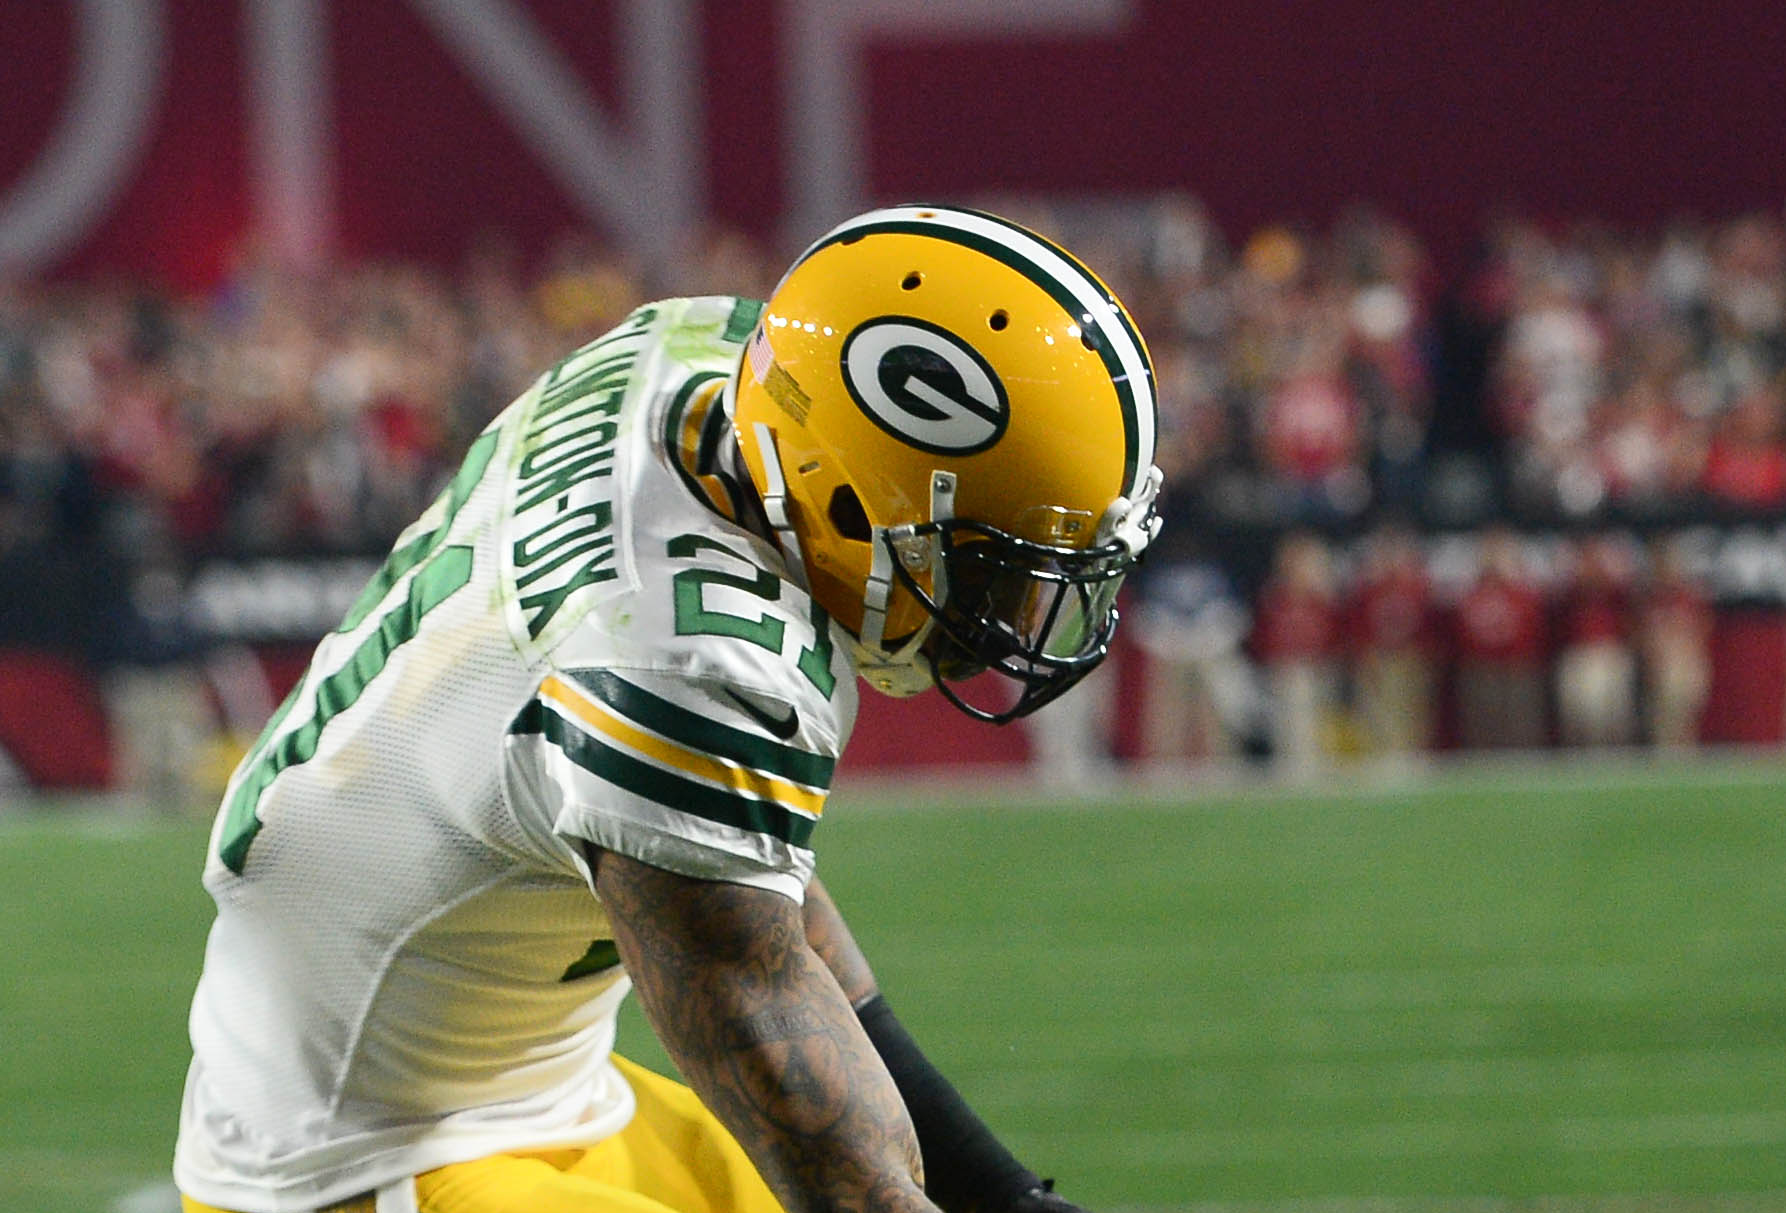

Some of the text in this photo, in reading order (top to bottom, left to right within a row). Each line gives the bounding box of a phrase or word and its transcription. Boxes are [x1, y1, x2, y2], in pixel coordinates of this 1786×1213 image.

[841, 315, 1010, 457] G
[513, 309, 657, 642] LINTON-DIX
[666, 533, 837, 703] 21
